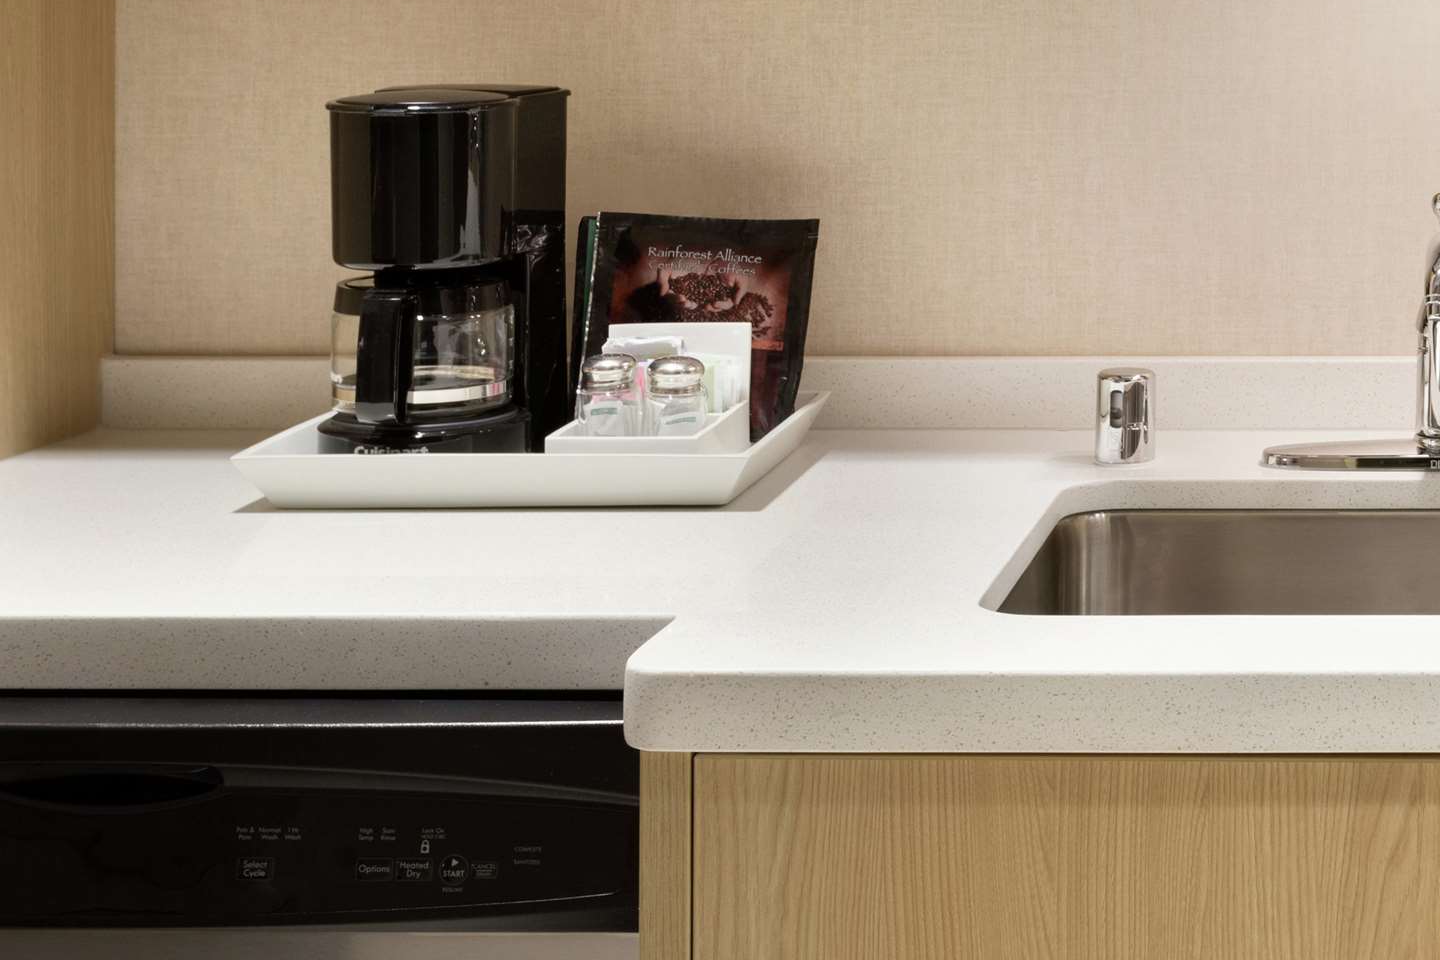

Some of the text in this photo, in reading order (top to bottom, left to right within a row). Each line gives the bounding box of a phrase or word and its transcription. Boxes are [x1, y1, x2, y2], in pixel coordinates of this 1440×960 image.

[647, 244, 762, 264] Rainforest Alliance
[243, 860, 267, 868] Select
[243, 869, 266, 878] Cycle
[358, 864, 390, 874] Options
[407, 870, 421, 879] Dry
[443, 870, 464, 878] START
